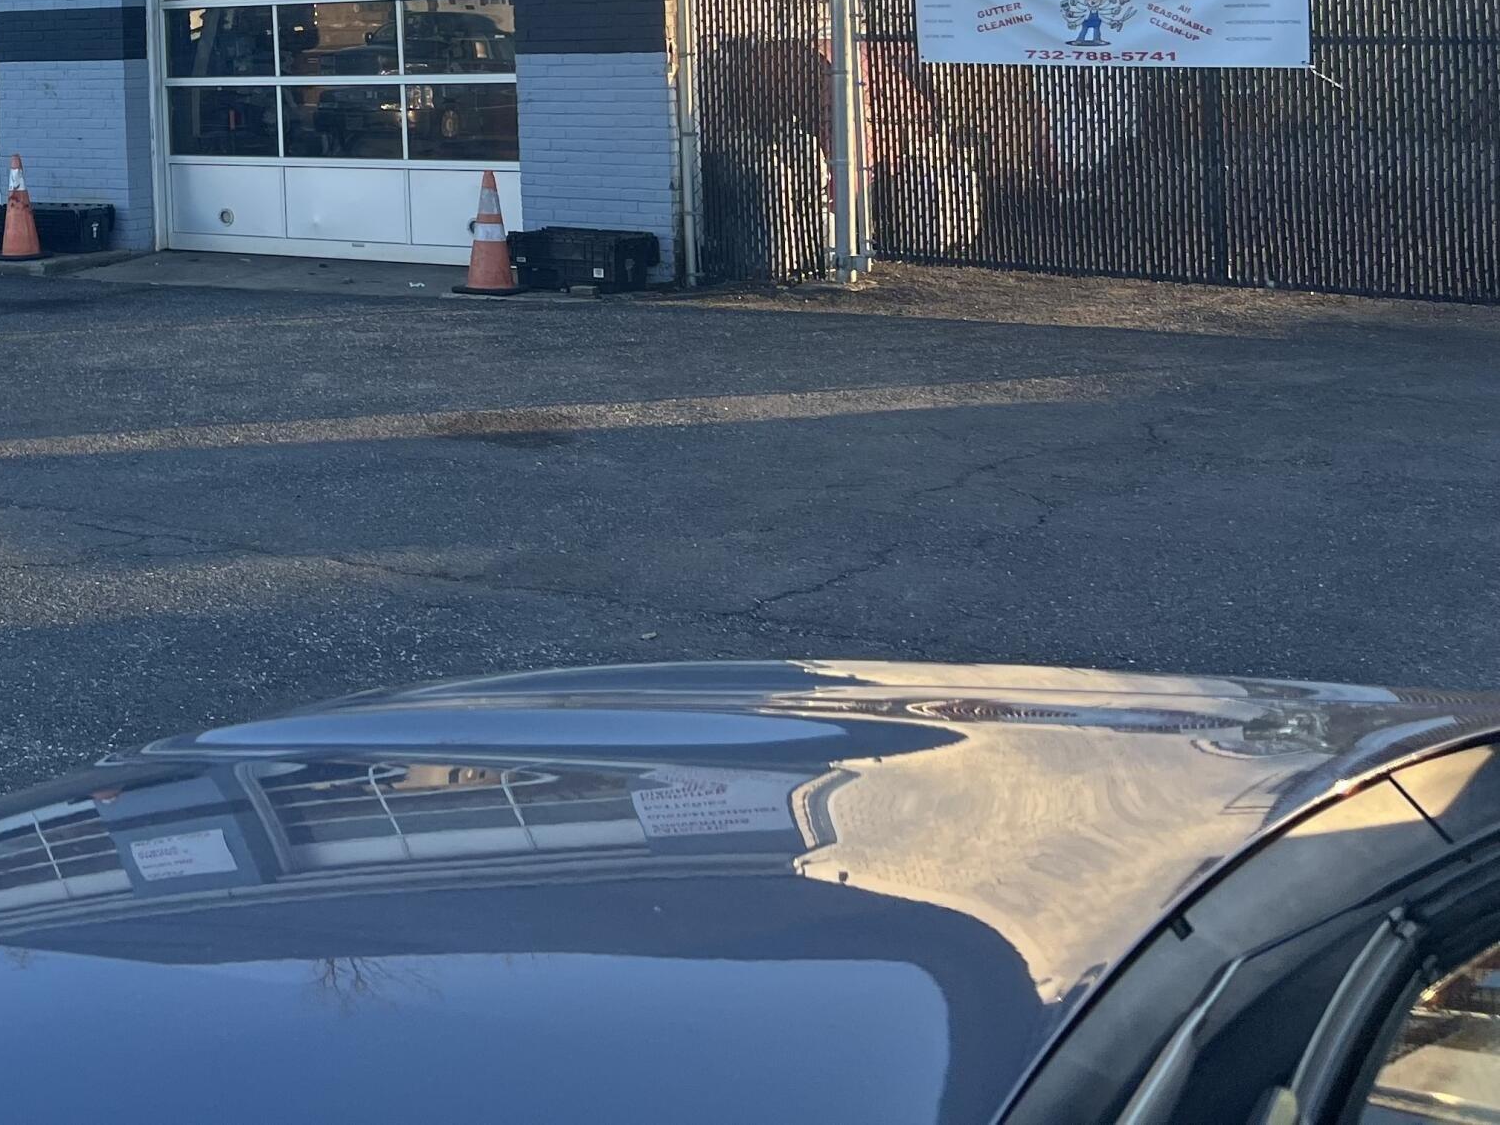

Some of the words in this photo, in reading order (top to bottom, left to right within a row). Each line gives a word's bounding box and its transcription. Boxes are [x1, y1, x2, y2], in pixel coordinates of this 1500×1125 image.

[977, 2, 1022, 19] GUTTER
[1147, 3, 1213, 36] SEASONABLE
[976, 13, 1033, 33] CLEANING
[1149, 17, 1200, 42] CLEAN-UP
[1024, 49, 1177, 62] 732-788-5741
